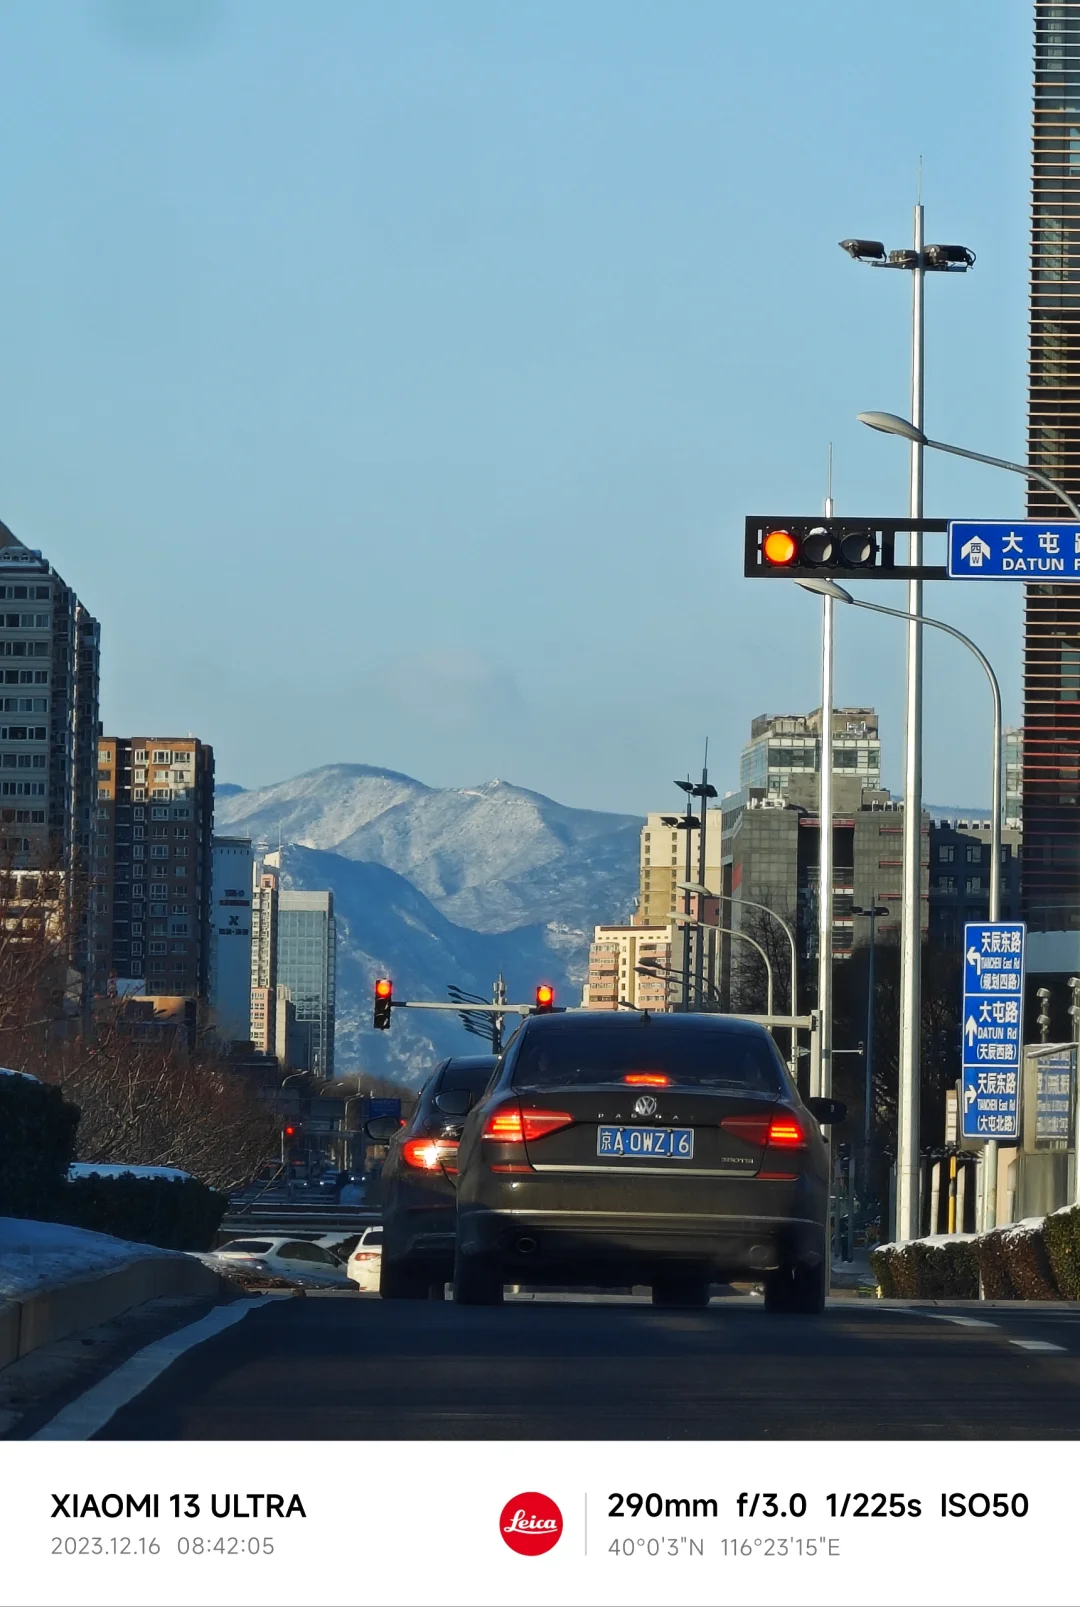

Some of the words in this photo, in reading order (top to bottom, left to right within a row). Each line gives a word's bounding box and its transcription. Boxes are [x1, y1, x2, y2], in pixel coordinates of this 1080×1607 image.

[970, 543, 982, 553] 西
[1002, 531, 1080, 554] 大屯
[971, 556, 980, 564] W
[1002, 558, 1064, 571] DATUN
[981, 931, 1021, 953] 天辰东路
[1013, 957, 1020, 970] Rd
[980, 973, 1020, 990] (规划四路)
[979, 1001, 1018, 1024] 大屯路
[977, 1027, 1004, 1040] DATUN
[1007, 1027, 1017, 1040] Rd
[976, 1043, 1017, 1060] (天辰西路)
[977, 1072, 1016, 1095] 天辰东路
[977, 1114, 1016, 1132] (大屯北路)
